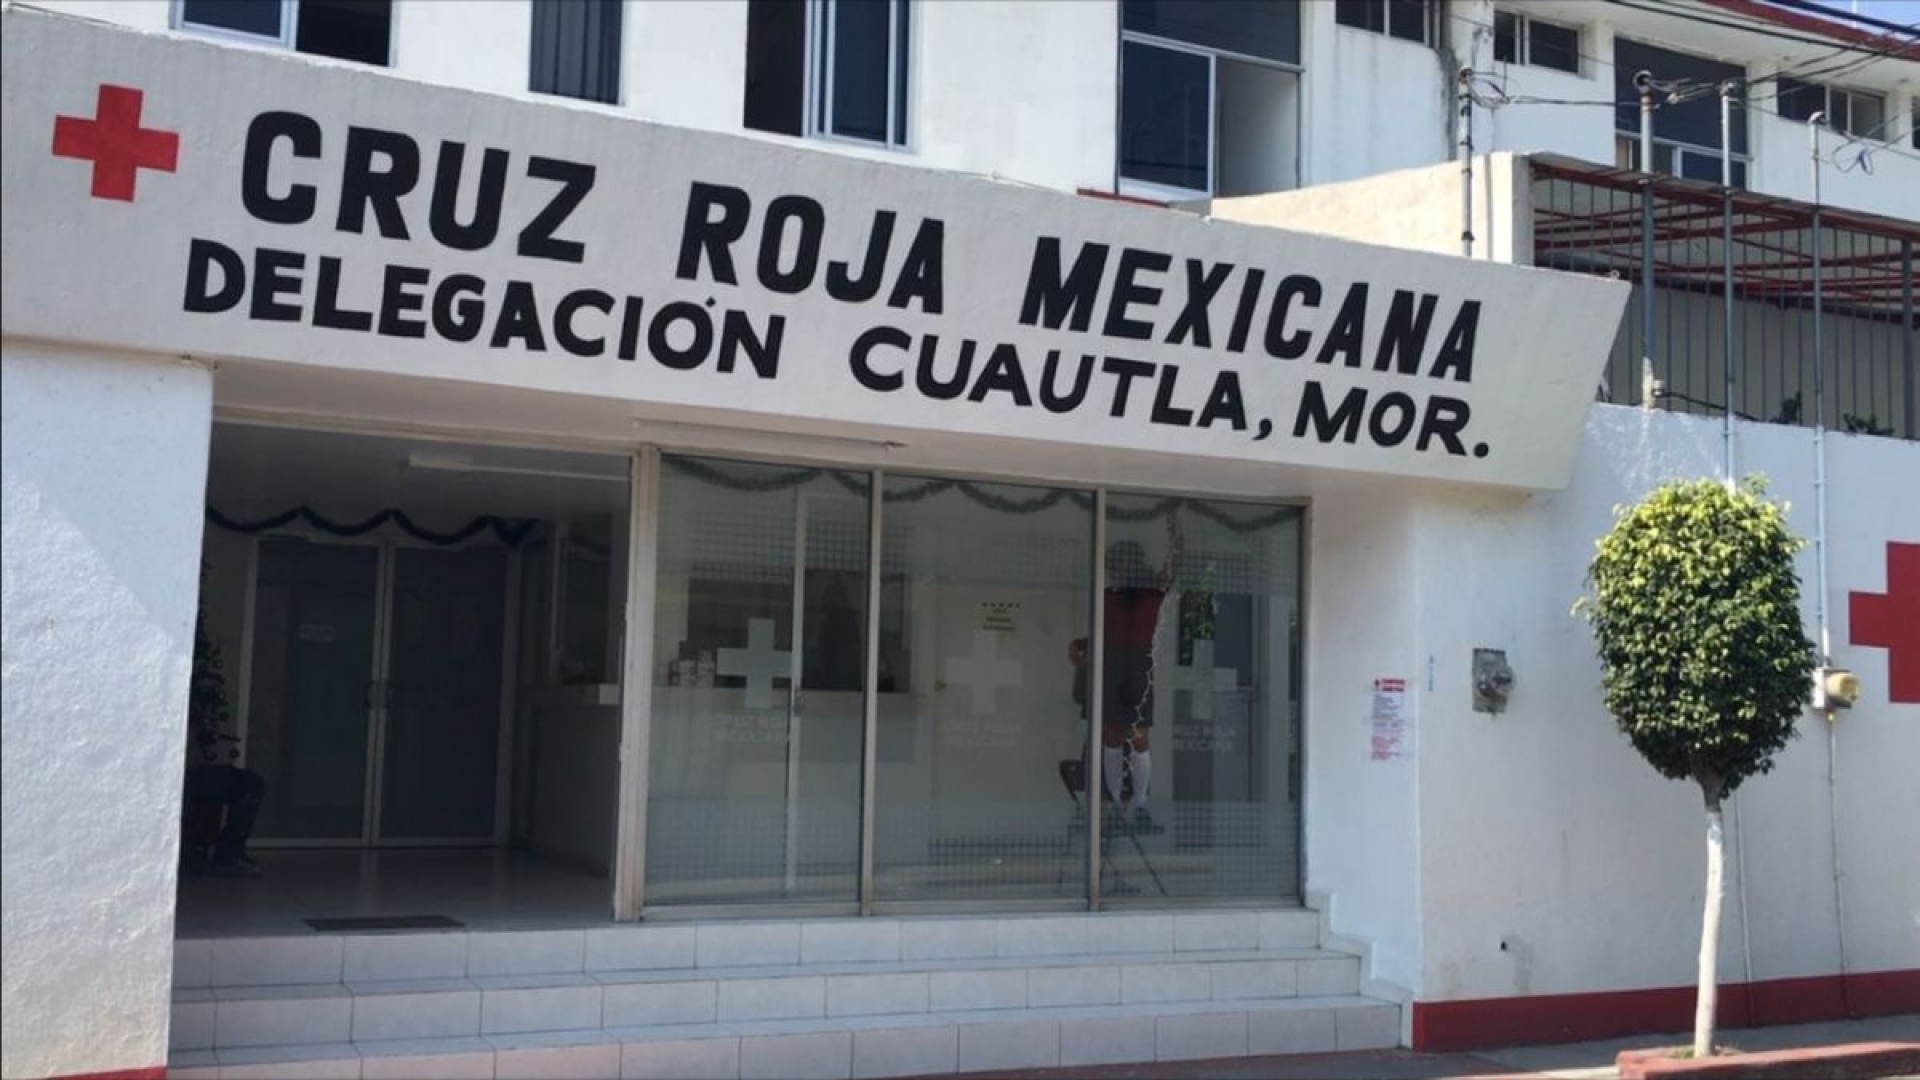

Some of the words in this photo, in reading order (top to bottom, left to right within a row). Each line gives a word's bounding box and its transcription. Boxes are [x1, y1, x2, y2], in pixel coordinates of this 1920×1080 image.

[183, 237, 787, 379] DELEGACIÓN
[849, 325, 1273, 441] CUAUTLA,
[1292, 380, 1490, 459] MOR.
[241, 111, 597, 264] CRUZ
[676, 181, 946, 315] ROJA
[1018, 236, 1482, 384] MEXICANA
